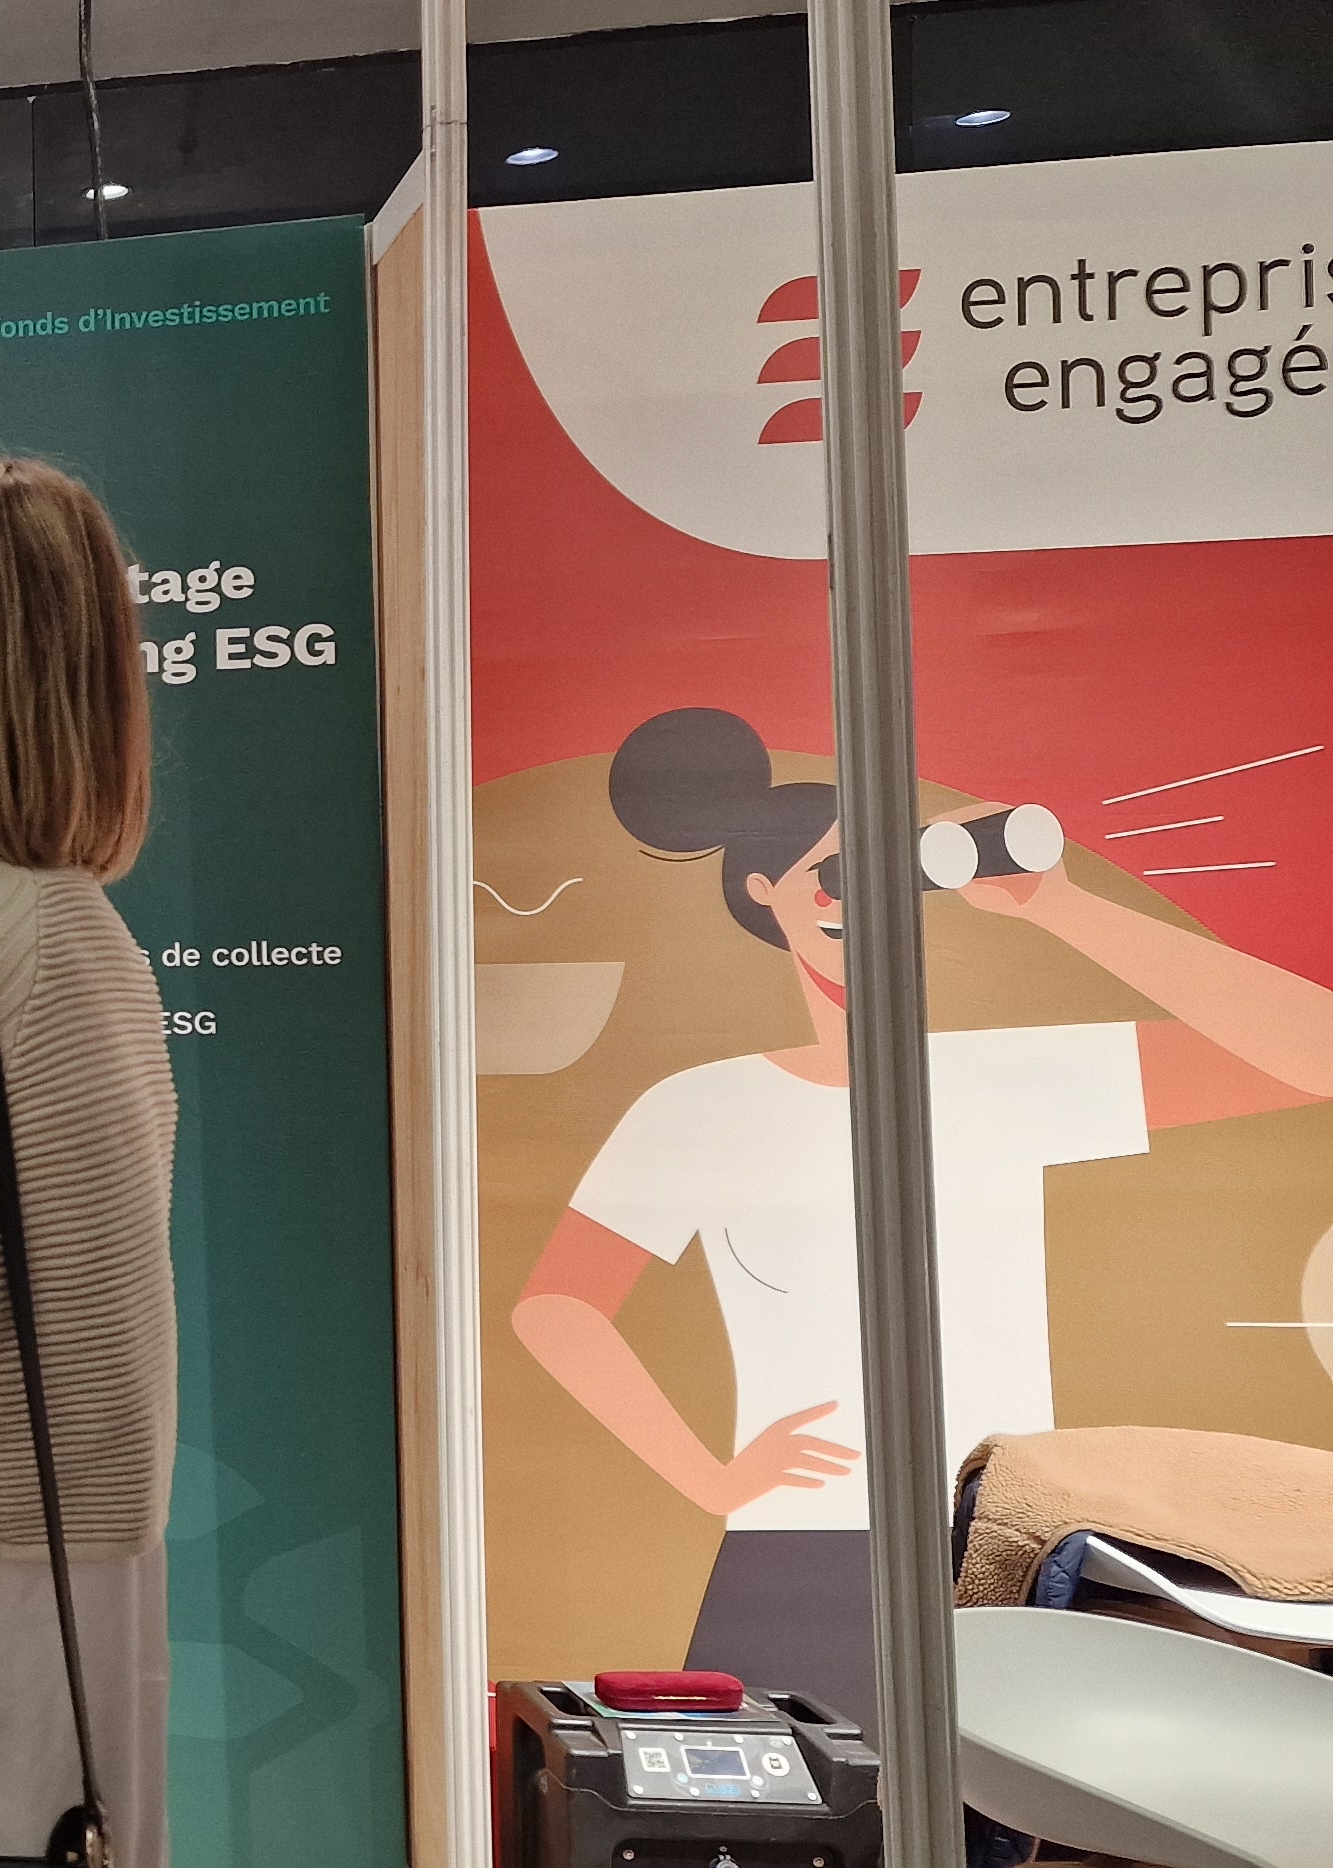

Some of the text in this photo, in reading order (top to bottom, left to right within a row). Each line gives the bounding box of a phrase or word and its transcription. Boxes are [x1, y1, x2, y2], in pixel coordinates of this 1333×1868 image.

[960, 243, 1333, 337] entrepri
[78, 292, 331, 332] d’Investissement
[215, 623, 337, 670] ESG
[161, 941, 202, 968] de
[211, 940, 343, 967] collecte
